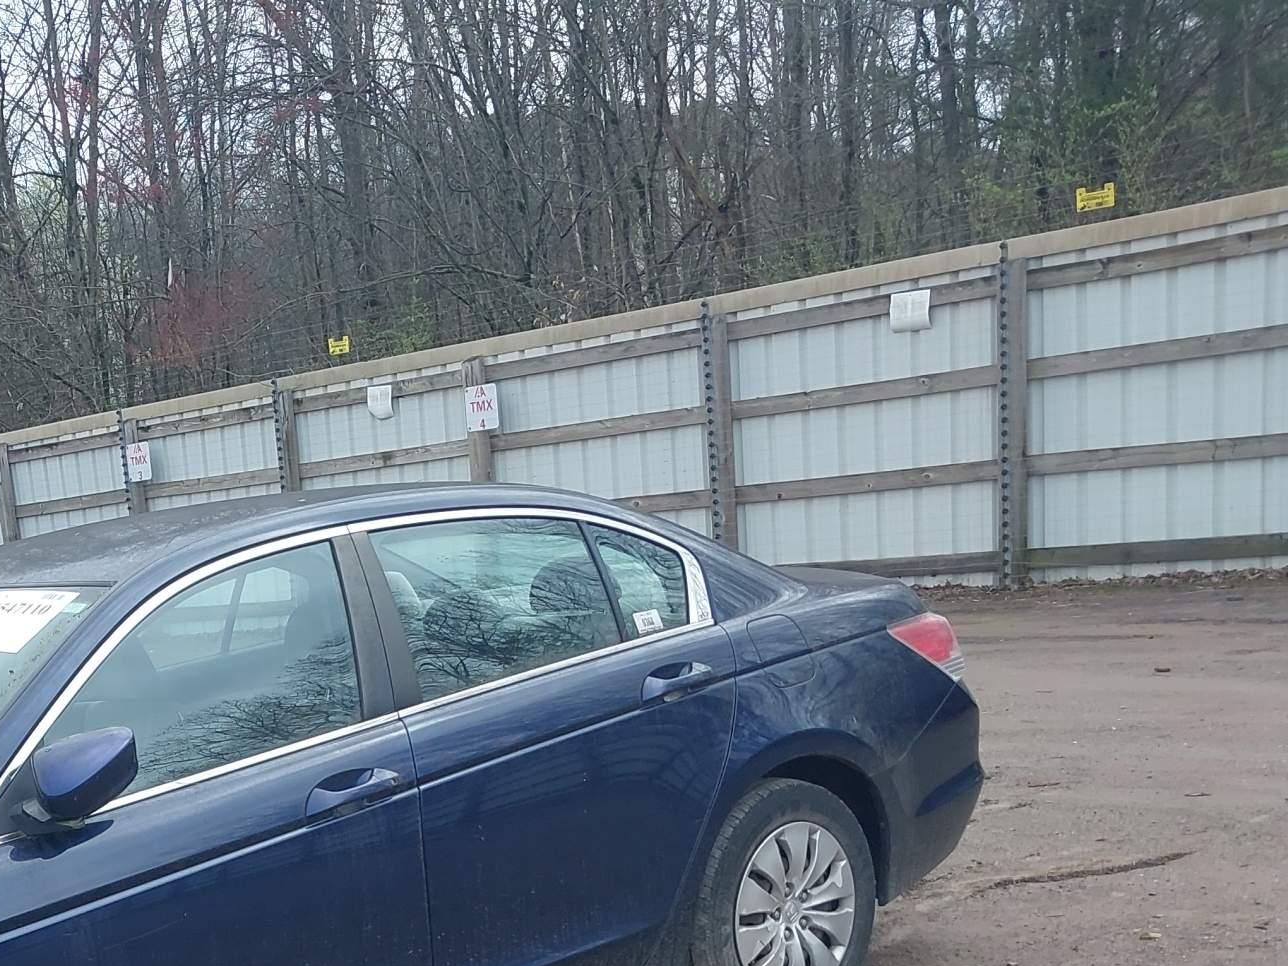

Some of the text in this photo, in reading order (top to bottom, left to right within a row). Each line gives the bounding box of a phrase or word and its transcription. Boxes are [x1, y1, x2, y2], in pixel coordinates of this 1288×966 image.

[469, 399, 493, 413] TMX
[479, 418, 486, 429] 4
[130, 454, 148, 466] TMX
[137, 470, 143, 480] 3
